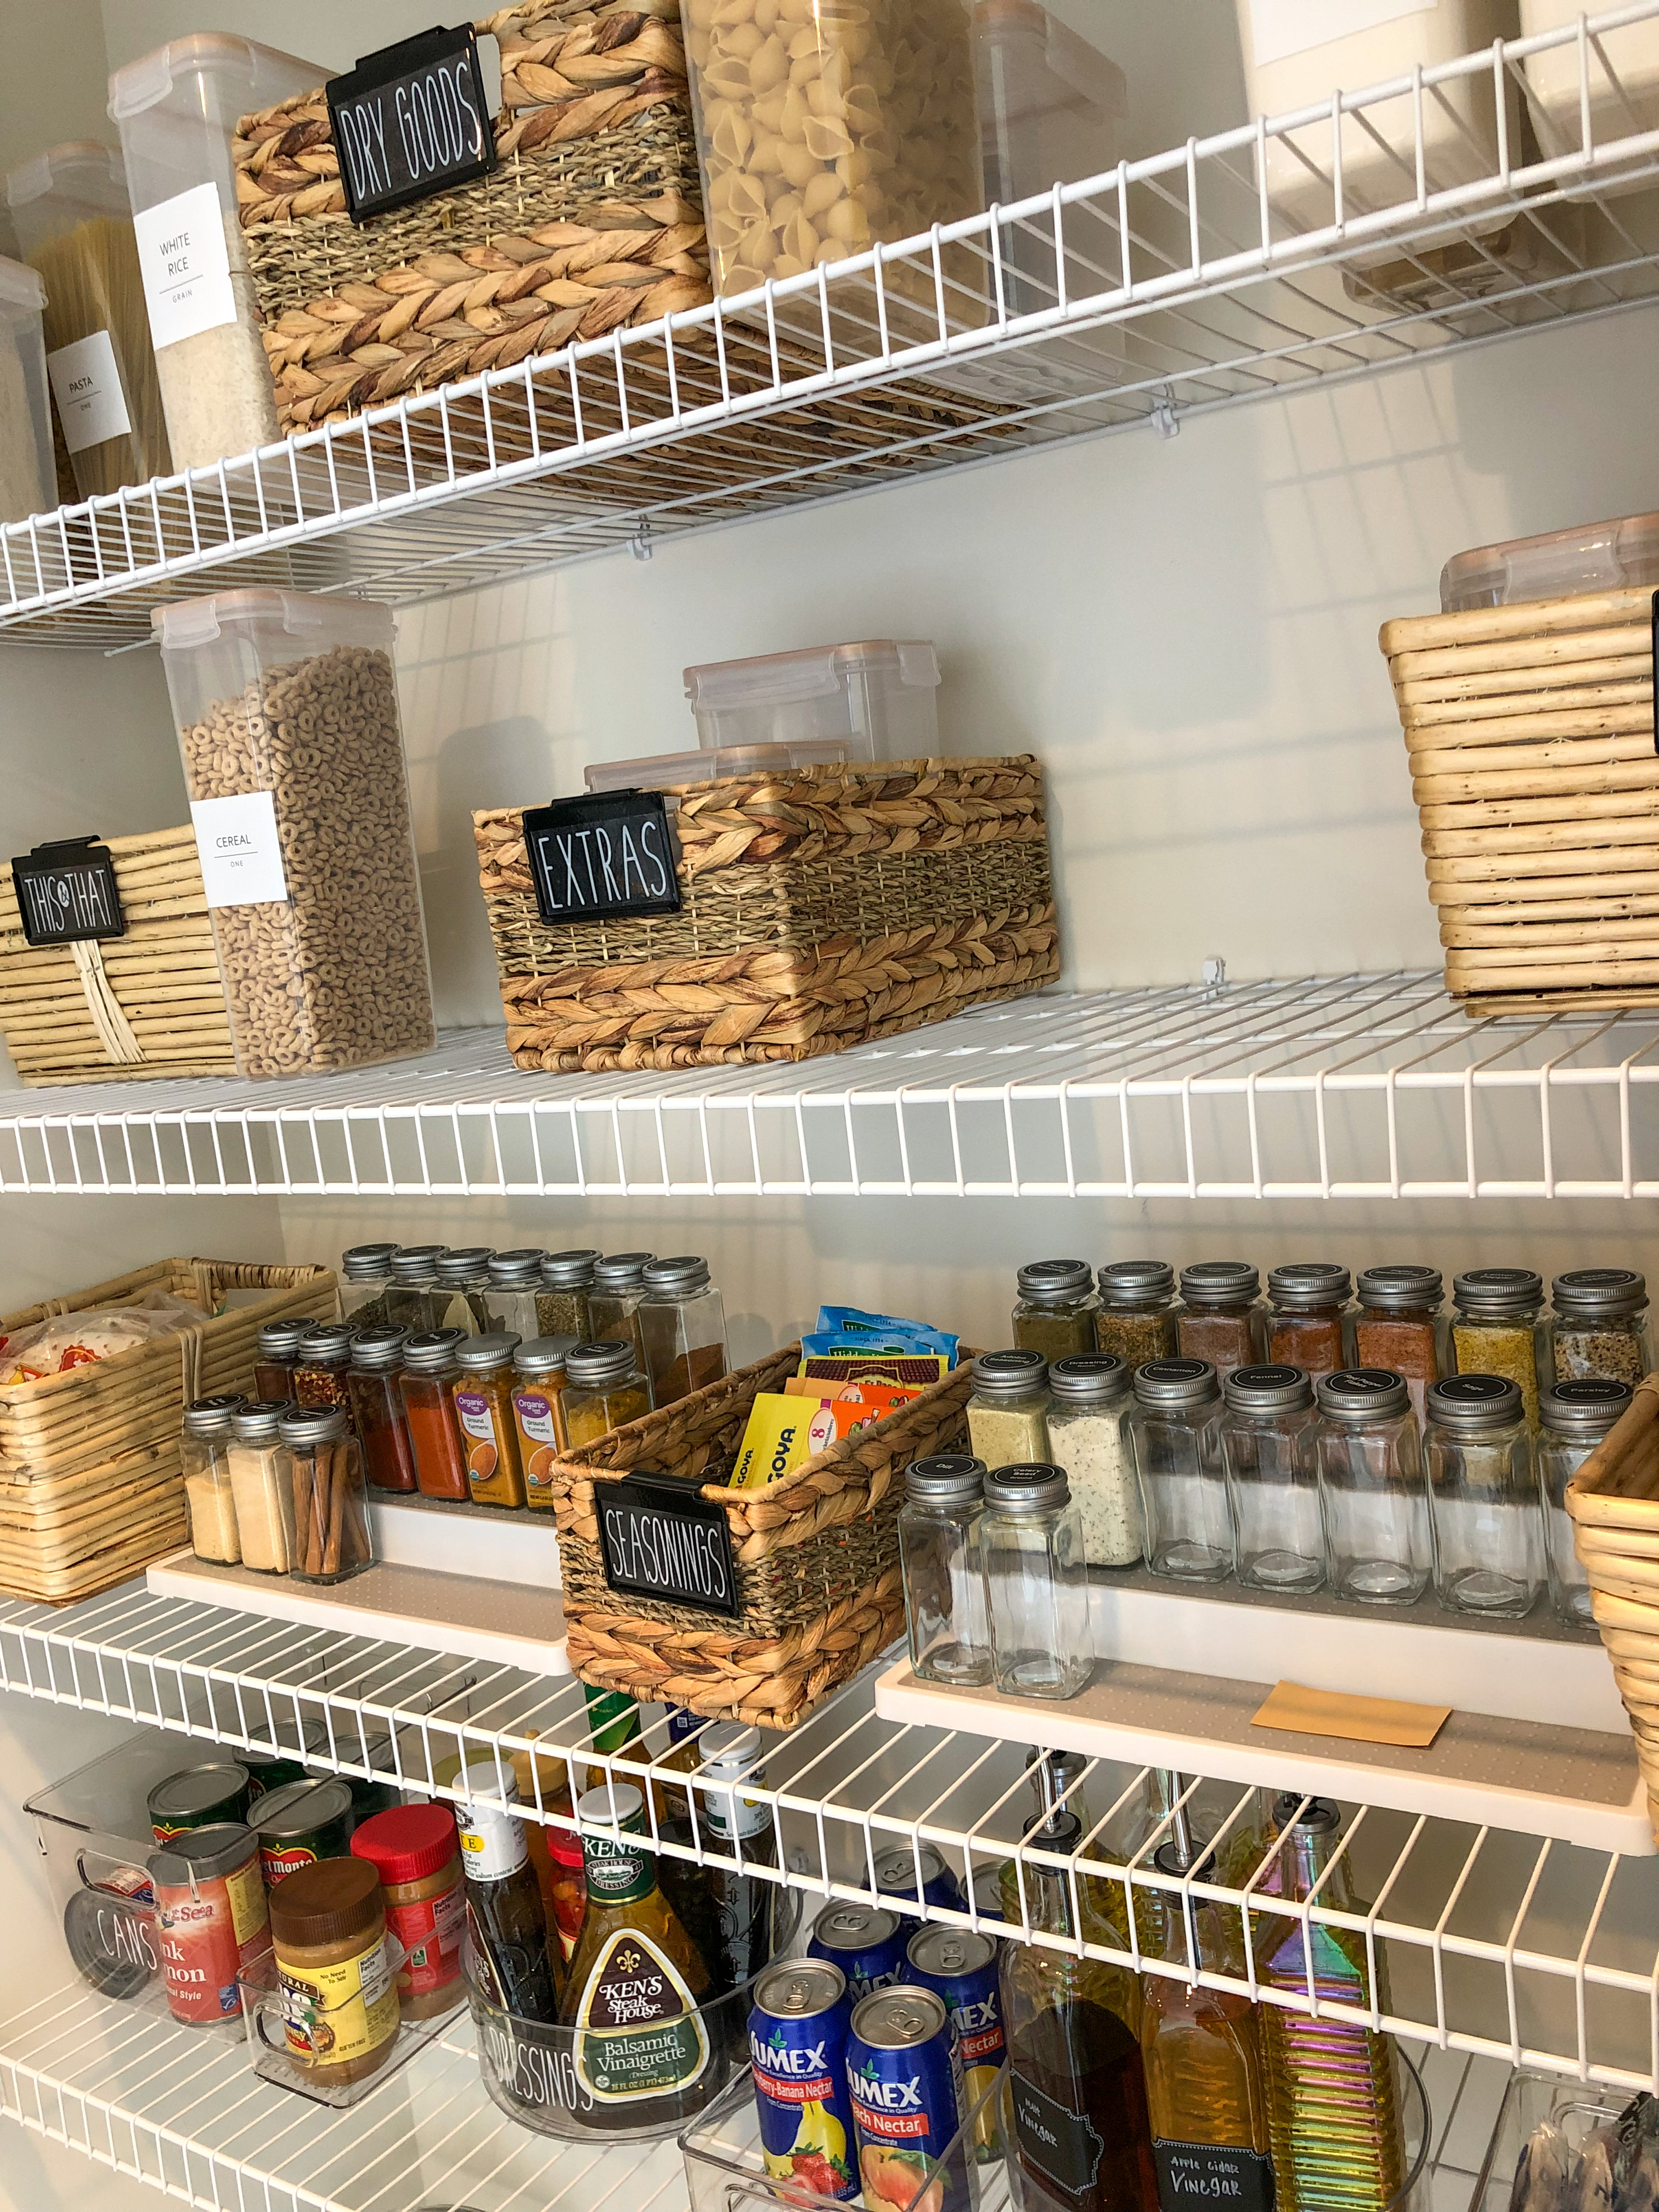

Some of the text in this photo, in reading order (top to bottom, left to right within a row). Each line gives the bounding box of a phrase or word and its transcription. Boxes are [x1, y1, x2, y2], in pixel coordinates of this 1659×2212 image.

[340, 61, 481, 201] DRY GOODS
[159, 232, 191, 257] WHITE
[167, 256, 190, 276] RICE
[172, 289, 193, 303] GRAIN
[68, 376, 94, 394] PASTA
[216, 834, 252, 849] CEREAL
[230, 860, 244, 868] ONE
[538, 821, 667, 909] EXTRAS
[24, 876, 65, 933] THIS
[64, 869, 112, 929] THAT
[458, 1396, 484, 1408] Organic
[518, 1399, 546, 1410] Organic
[811, 1428, 825, 1438] 8
[768, 1427, 796, 1483] GOYA
[737, 1449, 754, 1484] GOYA
[605, 1509, 725, 1599] SEASONINGS
[595, 1877, 634, 1888] DRESSING
[97, 1909, 157, 1971] CANS
[330, 1968, 347, 1978] Need
[179, 1989, 202, 2001] Style
[599, 1975, 663, 2001] KEN'S
[607, 1995, 648, 2013] Steak
[613, 2003, 662, 2024] House
[603, 2033, 677, 2057] Balsamic
[750, 2030, 829, 2074] JUMEX
[596, 2046, 686, 2072] Vinaigrette
[805, 2081, 832, 2098] Nectar
[873, 2114, 920, 2133] Nectar
